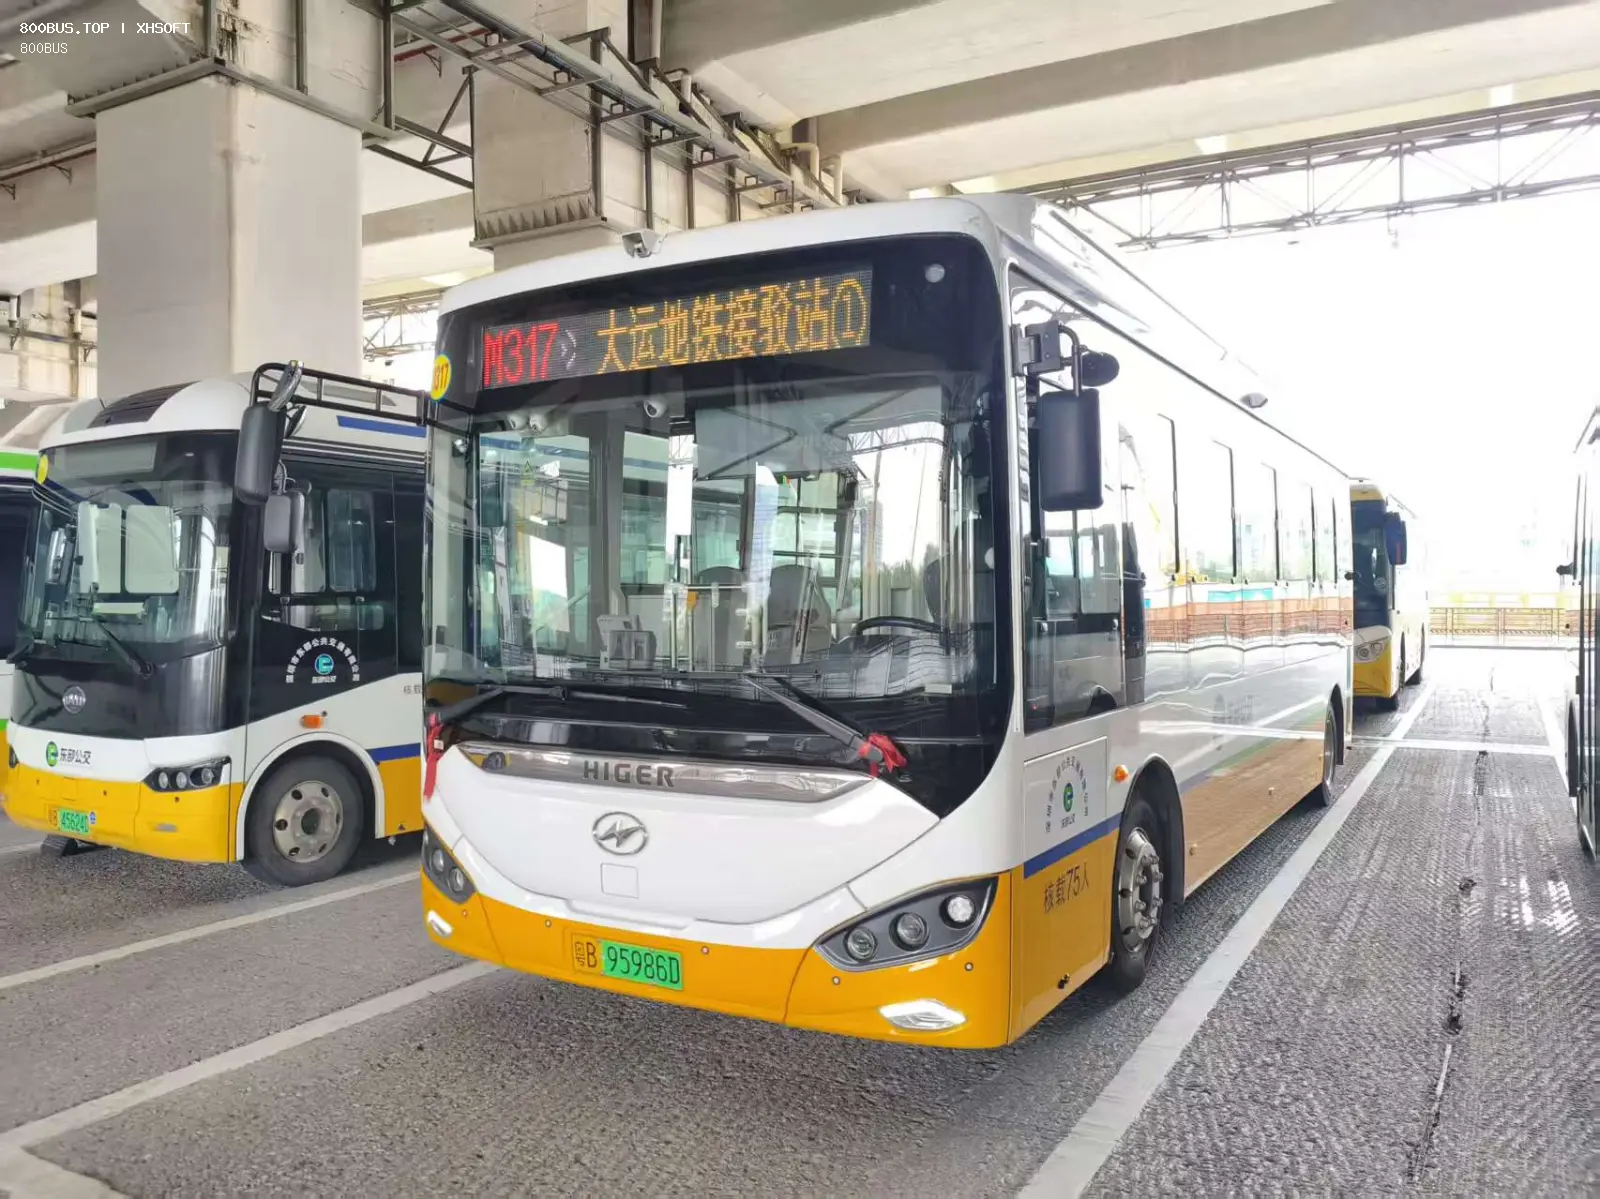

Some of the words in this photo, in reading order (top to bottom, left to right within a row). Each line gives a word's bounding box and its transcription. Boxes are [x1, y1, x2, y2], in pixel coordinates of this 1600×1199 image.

[484, 321, 559, 387] M317
[60, 747, 92, 765] 东部公交
[583, 760, 675, 788] HIGER
[606, 945, 681, 985] 95986D
